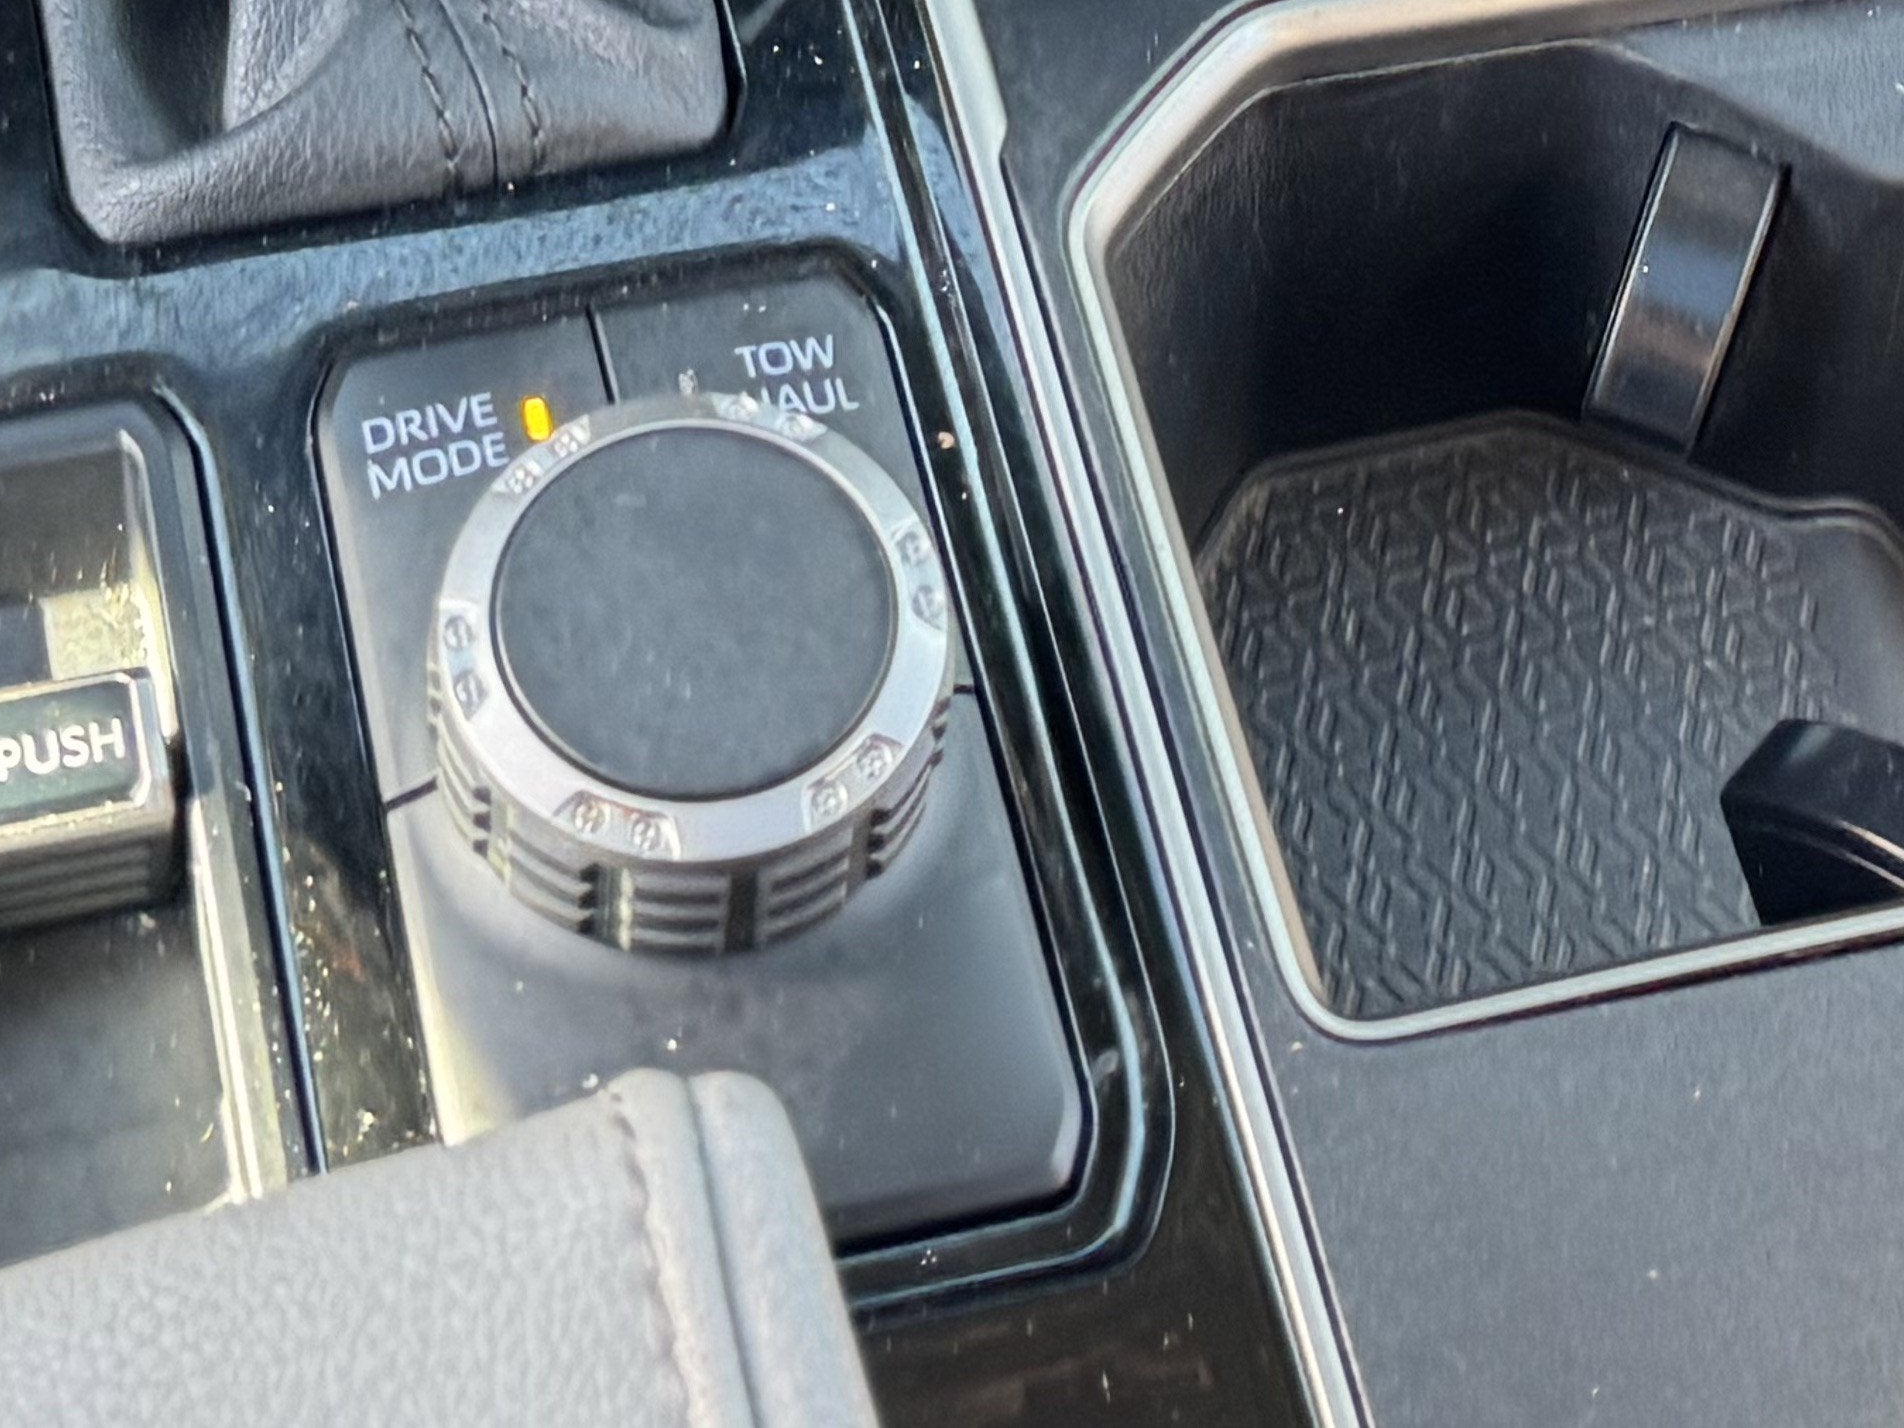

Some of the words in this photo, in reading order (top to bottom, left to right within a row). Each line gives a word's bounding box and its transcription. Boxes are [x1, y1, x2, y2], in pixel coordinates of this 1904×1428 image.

[733, 333, 834, 378] TOW
[360, 391, 498, 455] DRIVE
[366, 431, 511, 501] MODE
